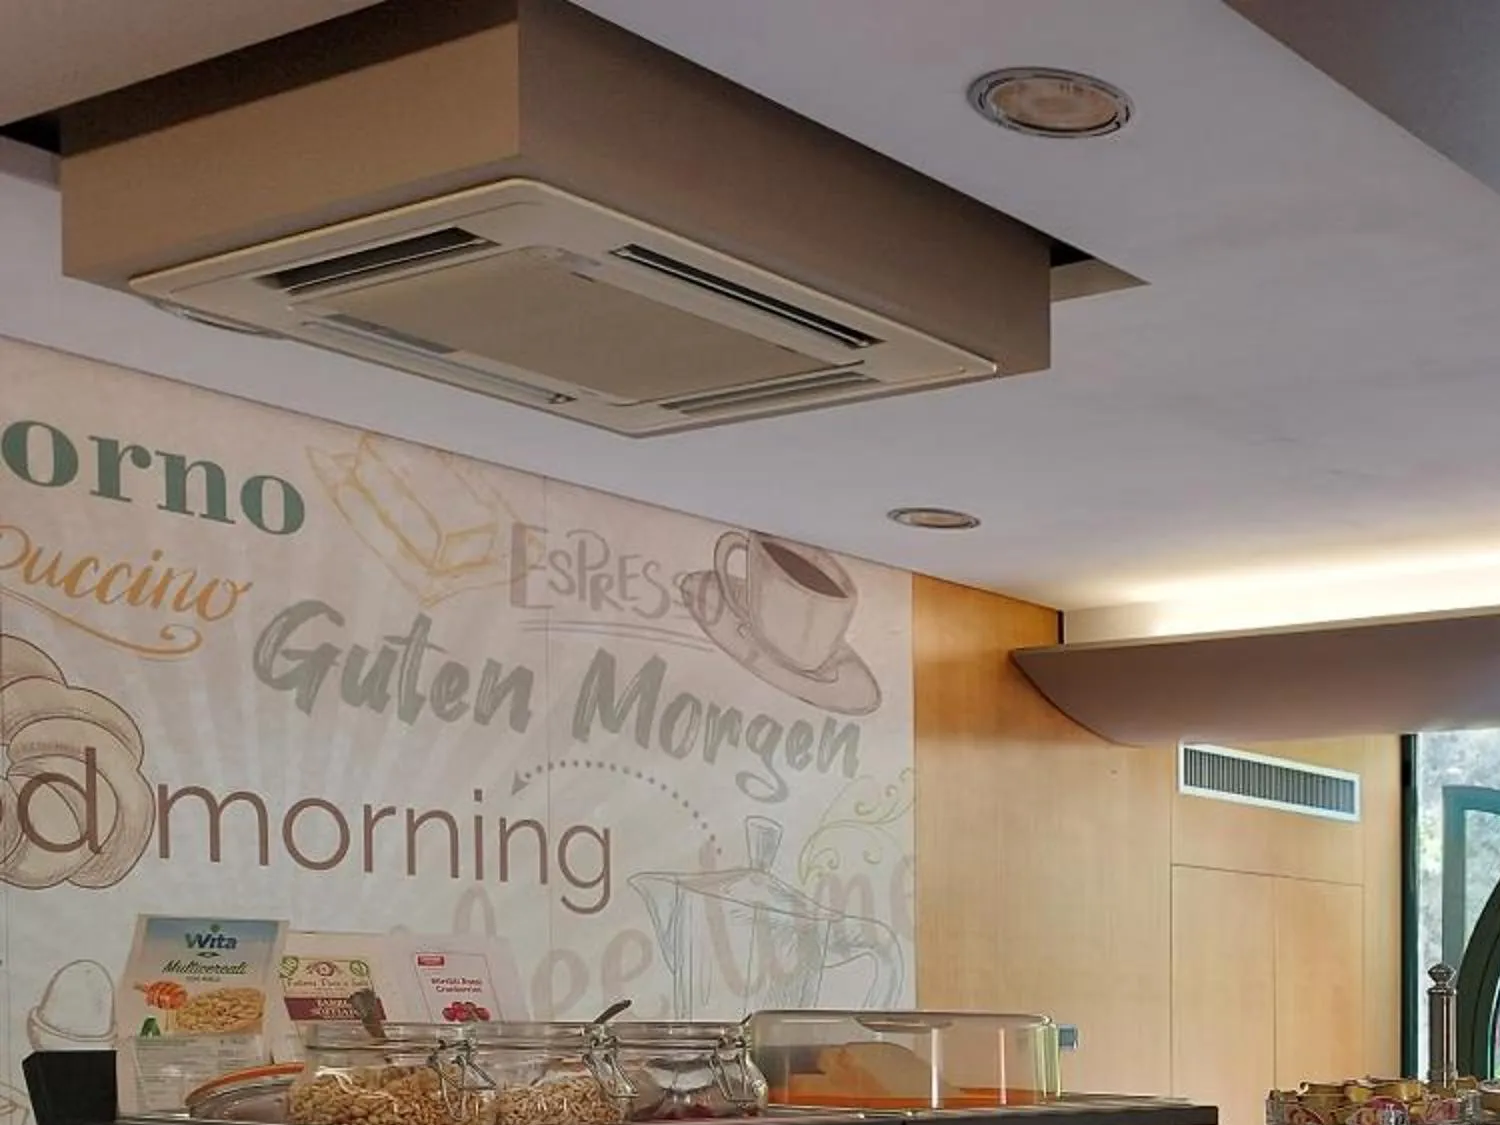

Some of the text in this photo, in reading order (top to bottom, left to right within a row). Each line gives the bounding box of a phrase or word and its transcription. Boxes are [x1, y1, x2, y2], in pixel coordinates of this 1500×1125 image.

[0, 420, 306, 535] orno
[252, 599, 861, 803] Guten Morgen
[0, 746, 611, 916] d morning
